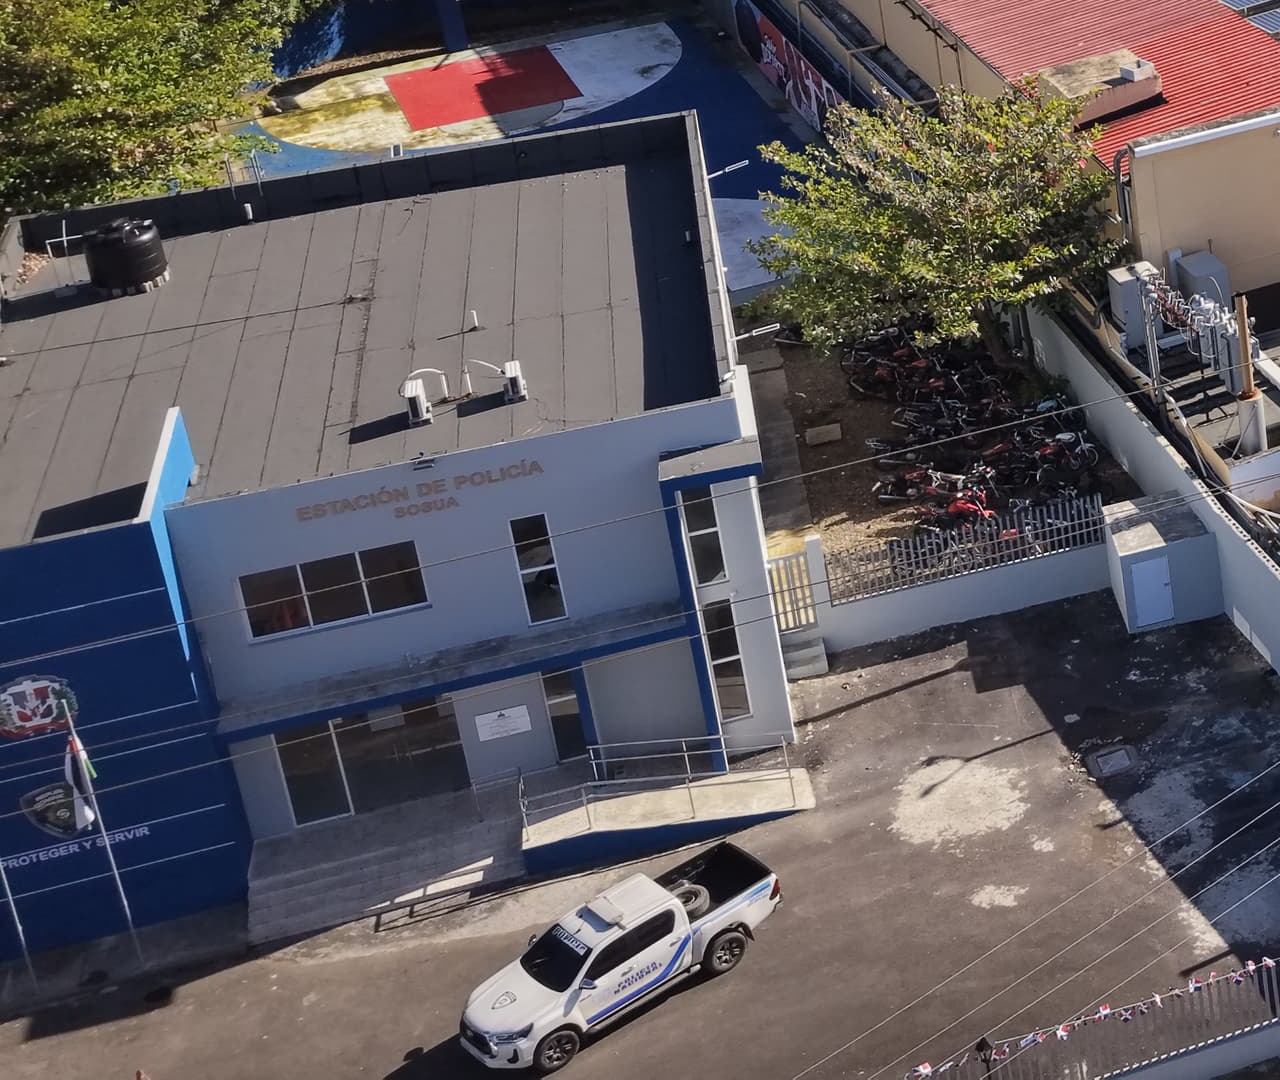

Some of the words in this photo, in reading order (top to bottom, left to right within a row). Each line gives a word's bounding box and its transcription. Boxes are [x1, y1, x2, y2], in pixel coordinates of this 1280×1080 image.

[296, 486, 409, 522] ESTACIÓN
[416, 478, 448, 498] DE
[454, 459, 544, 490] POLICÍA
[394, 496, 460, 519] SOSUA
[0, 844, 80, 869] PROTEGER
[82, 840, 93, 850] Y
[96, 826, 150, 847] SERVIR
